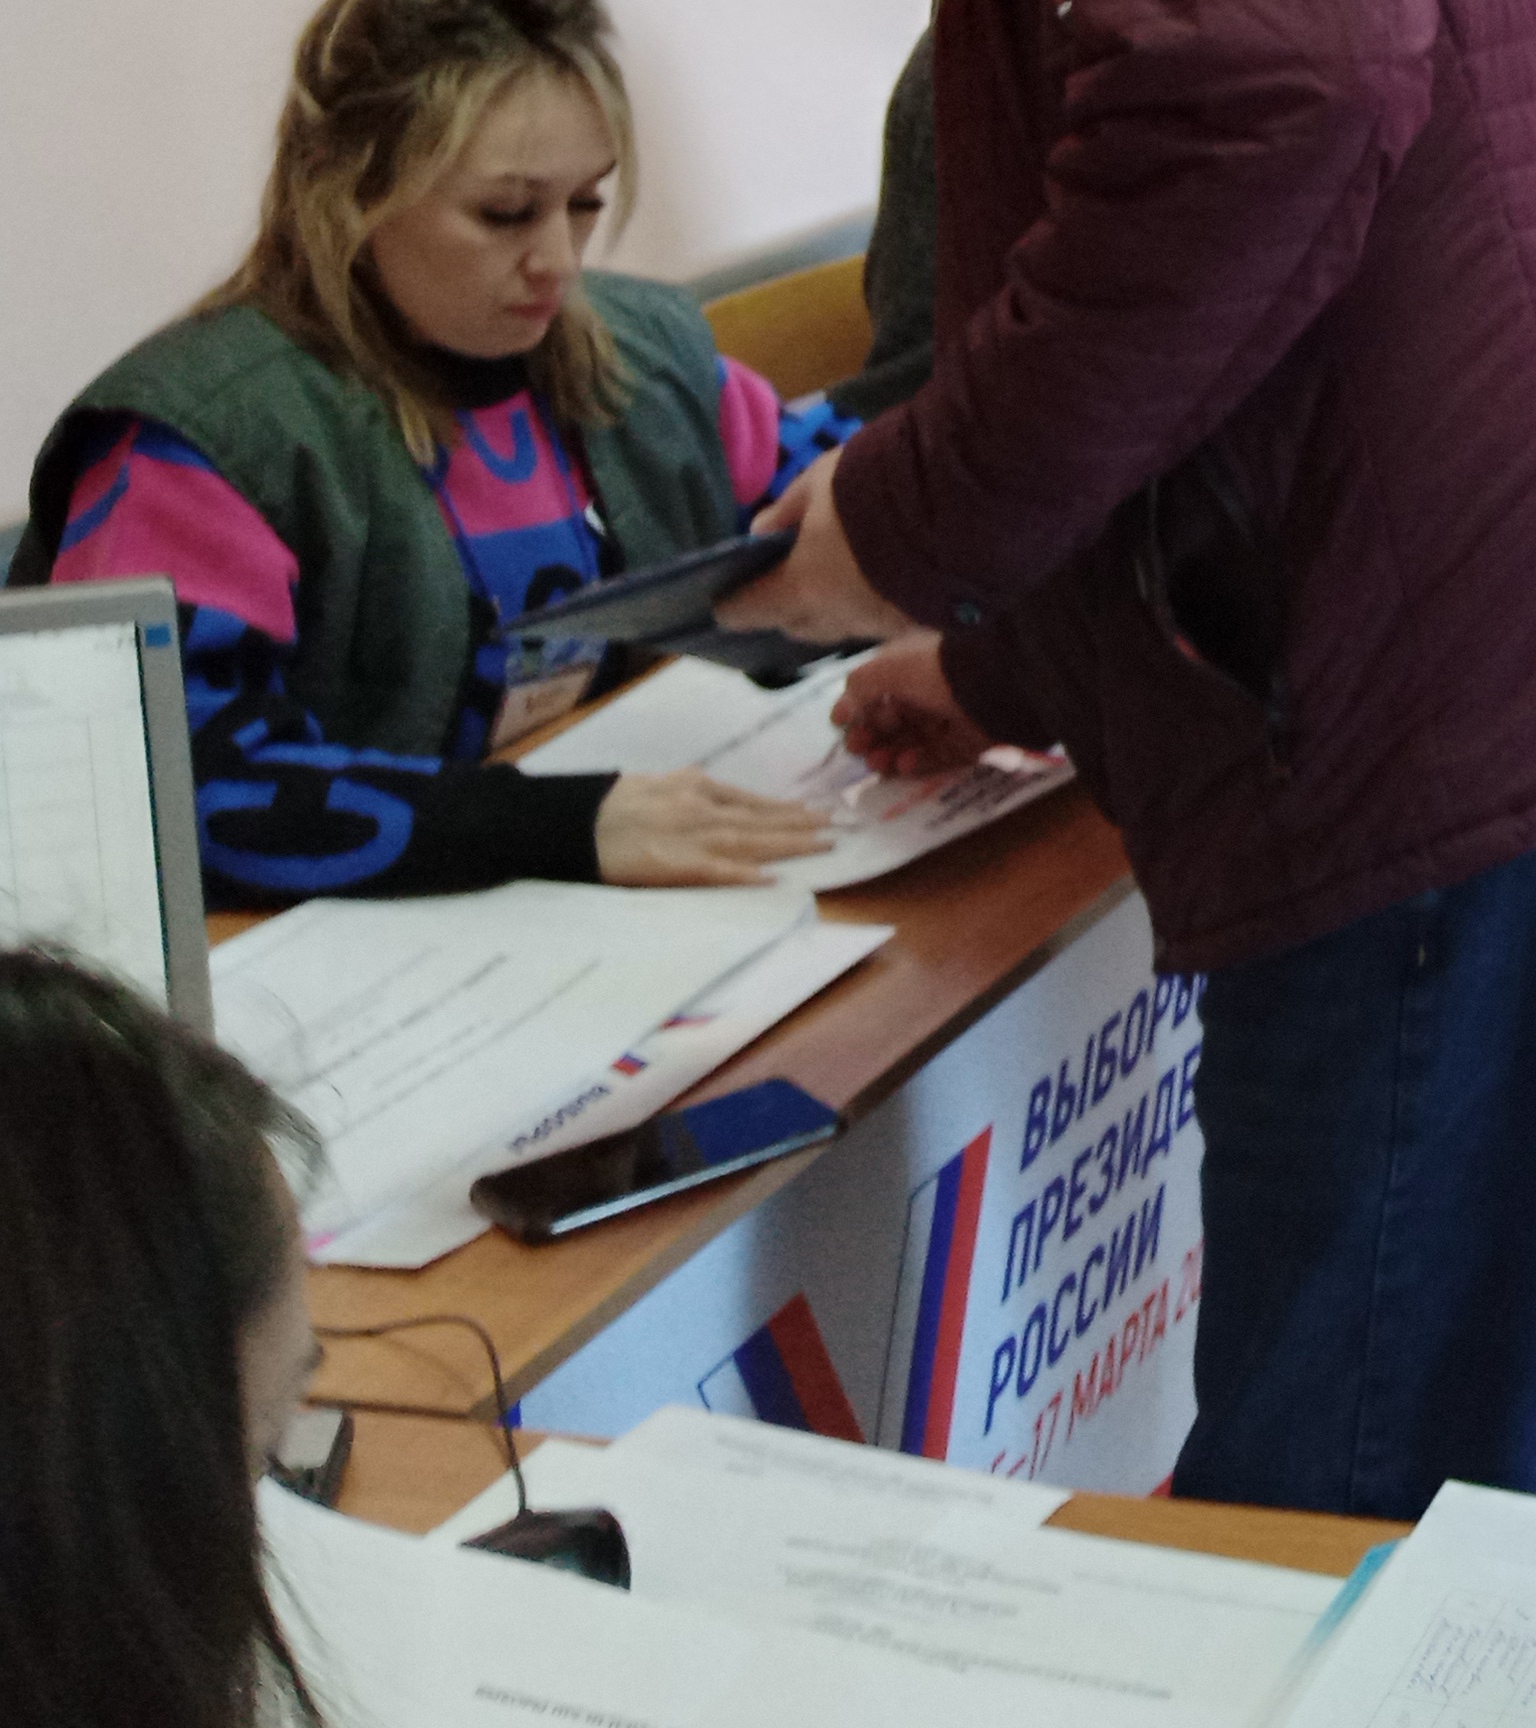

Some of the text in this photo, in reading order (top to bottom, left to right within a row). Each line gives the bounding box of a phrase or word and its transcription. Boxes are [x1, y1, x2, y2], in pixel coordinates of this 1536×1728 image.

[1001, 1043, 1203, 1304] ПРЕЗИДЕ
[983, 1182, 1166, 1437] РОССИИ
[1065, 1275, 1171, 1442] МАРТА
